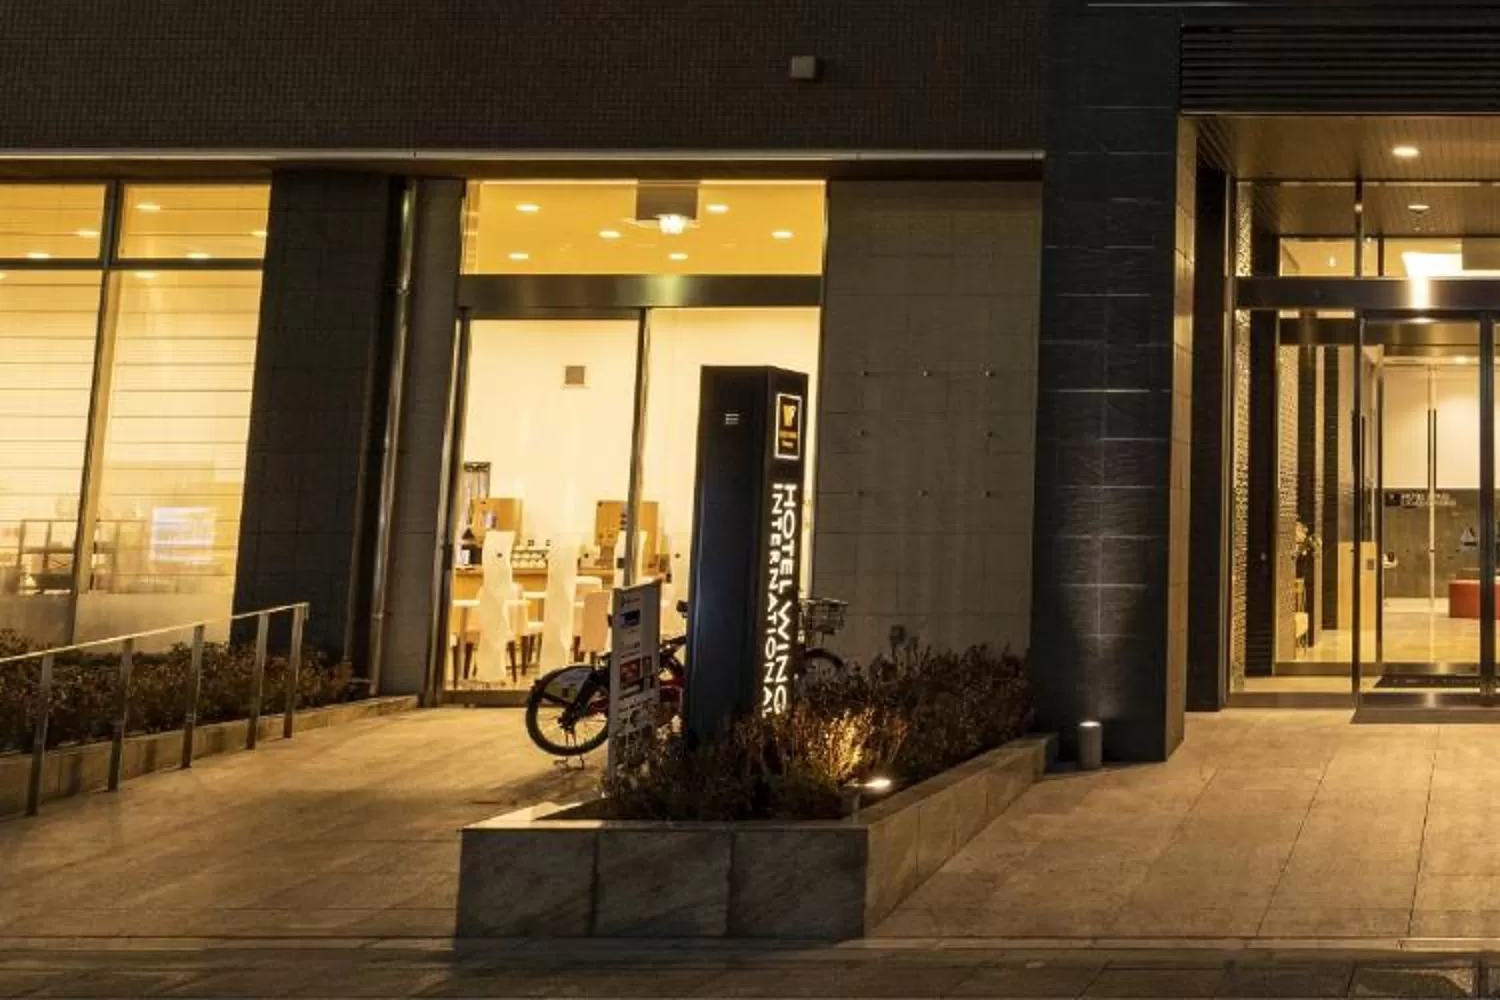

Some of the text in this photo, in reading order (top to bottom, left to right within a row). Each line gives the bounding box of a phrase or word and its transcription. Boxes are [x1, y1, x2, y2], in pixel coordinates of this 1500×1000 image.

[762, 483, 783, 719] INTERNATIONAL
[774, 484, 797, 715] HOTEL WING
